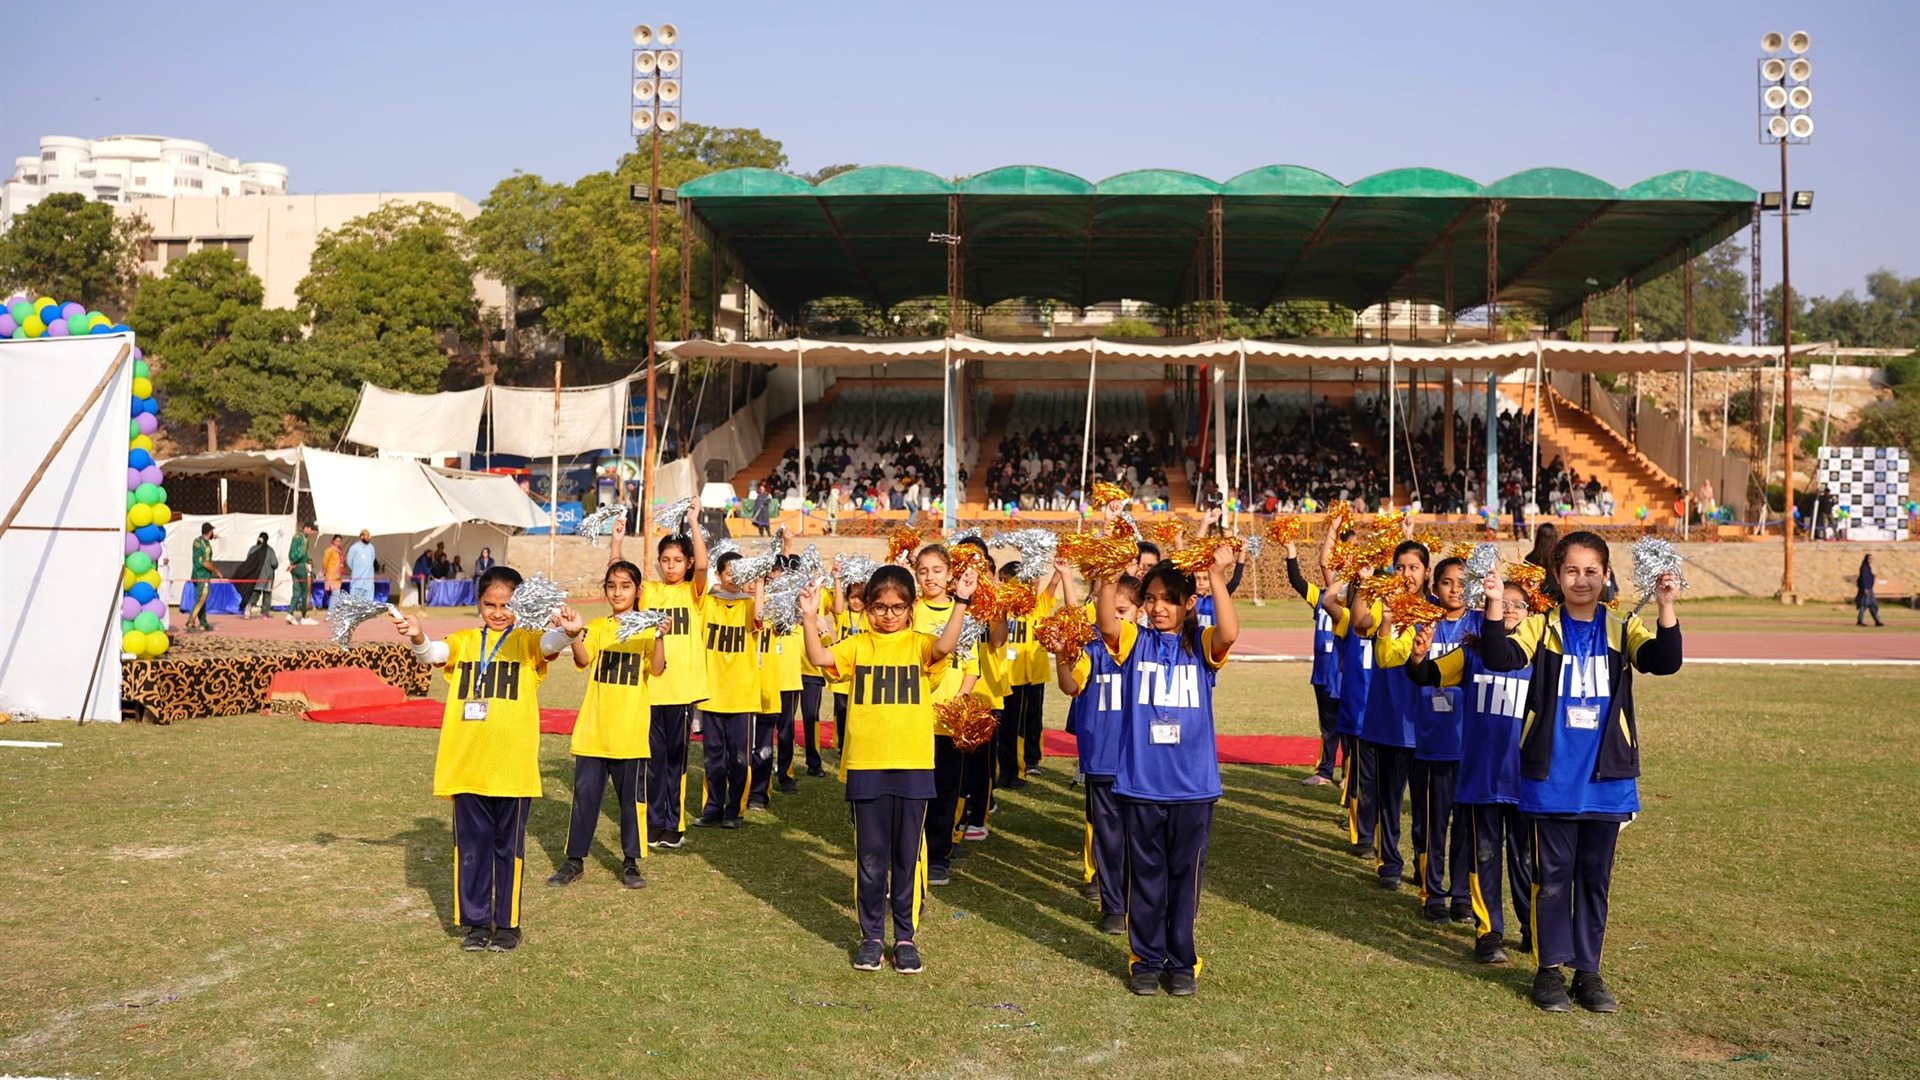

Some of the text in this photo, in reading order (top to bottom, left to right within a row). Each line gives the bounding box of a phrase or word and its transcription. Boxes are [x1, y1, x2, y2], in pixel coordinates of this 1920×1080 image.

[706, 623, 746, 653] THH
[457, 660, 520, 700] THH
[593, 649, 641, 687] HH
[854, 665, 920, 704] THH
